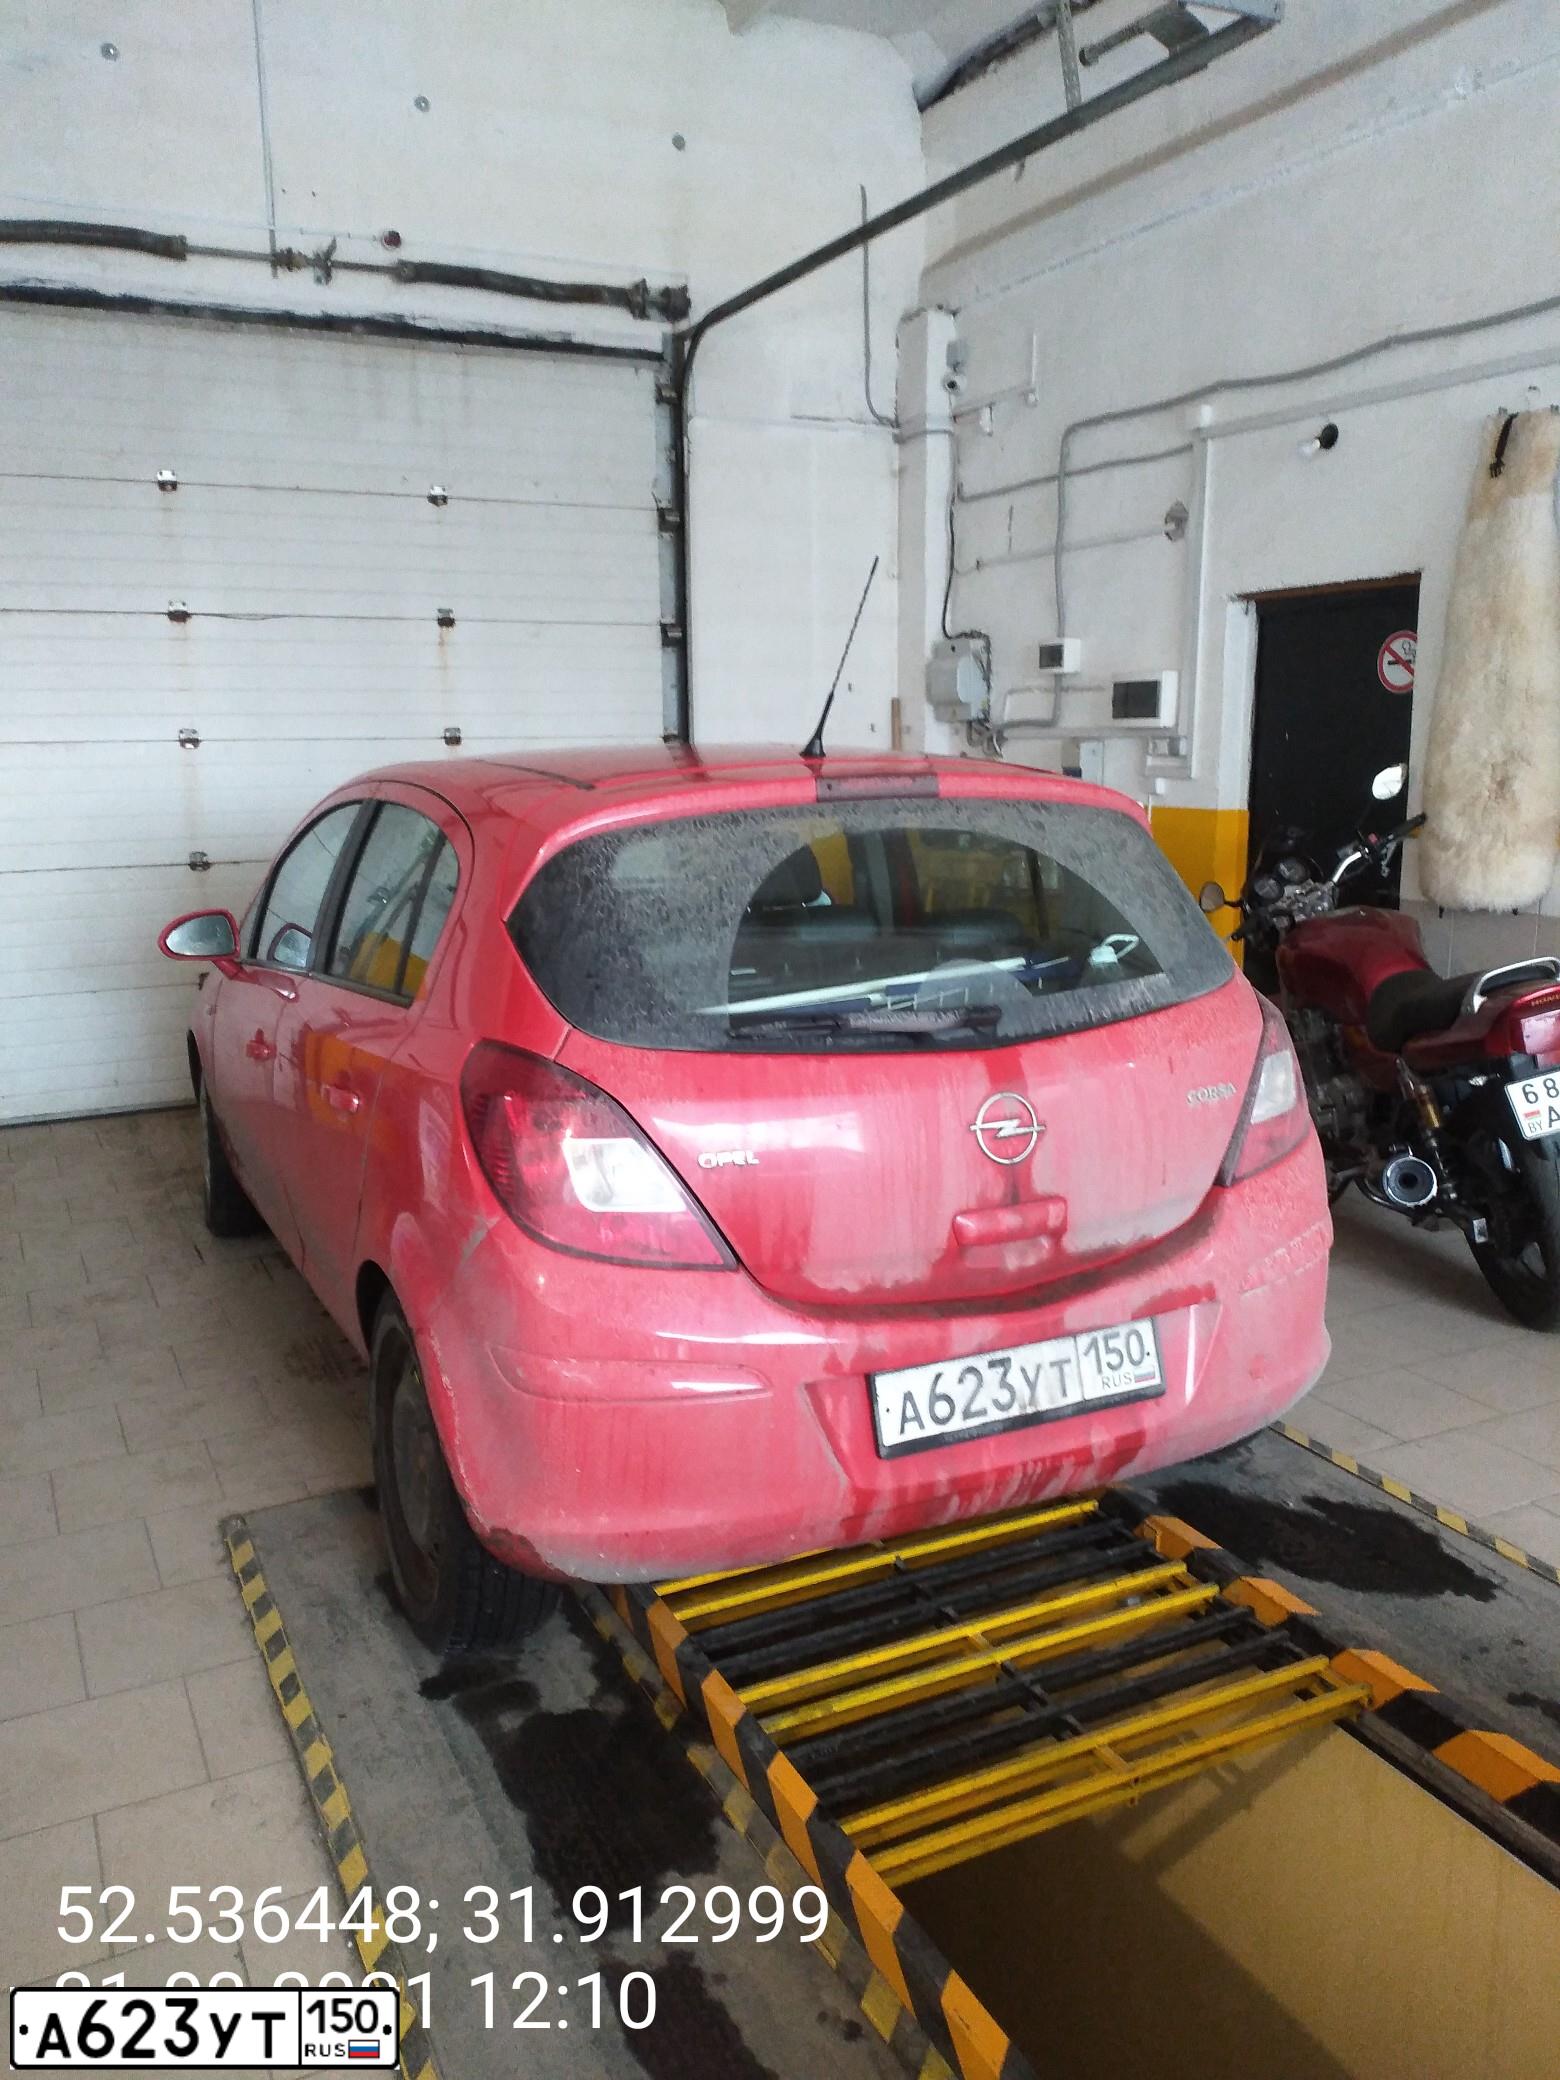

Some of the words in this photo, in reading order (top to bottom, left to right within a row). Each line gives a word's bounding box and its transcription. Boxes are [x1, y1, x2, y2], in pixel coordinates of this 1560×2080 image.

[1186, 1083, 1236, 1107] CORSA
[1522, 1078, 1560, 1104] 68
[1528, 1120, 1543, 1133] BY
[697, 1151, 760, 1169] OPEL
[1084, 1329, 1145, 1374] 150
[1101, 1371, 1133, 1390] RUS
